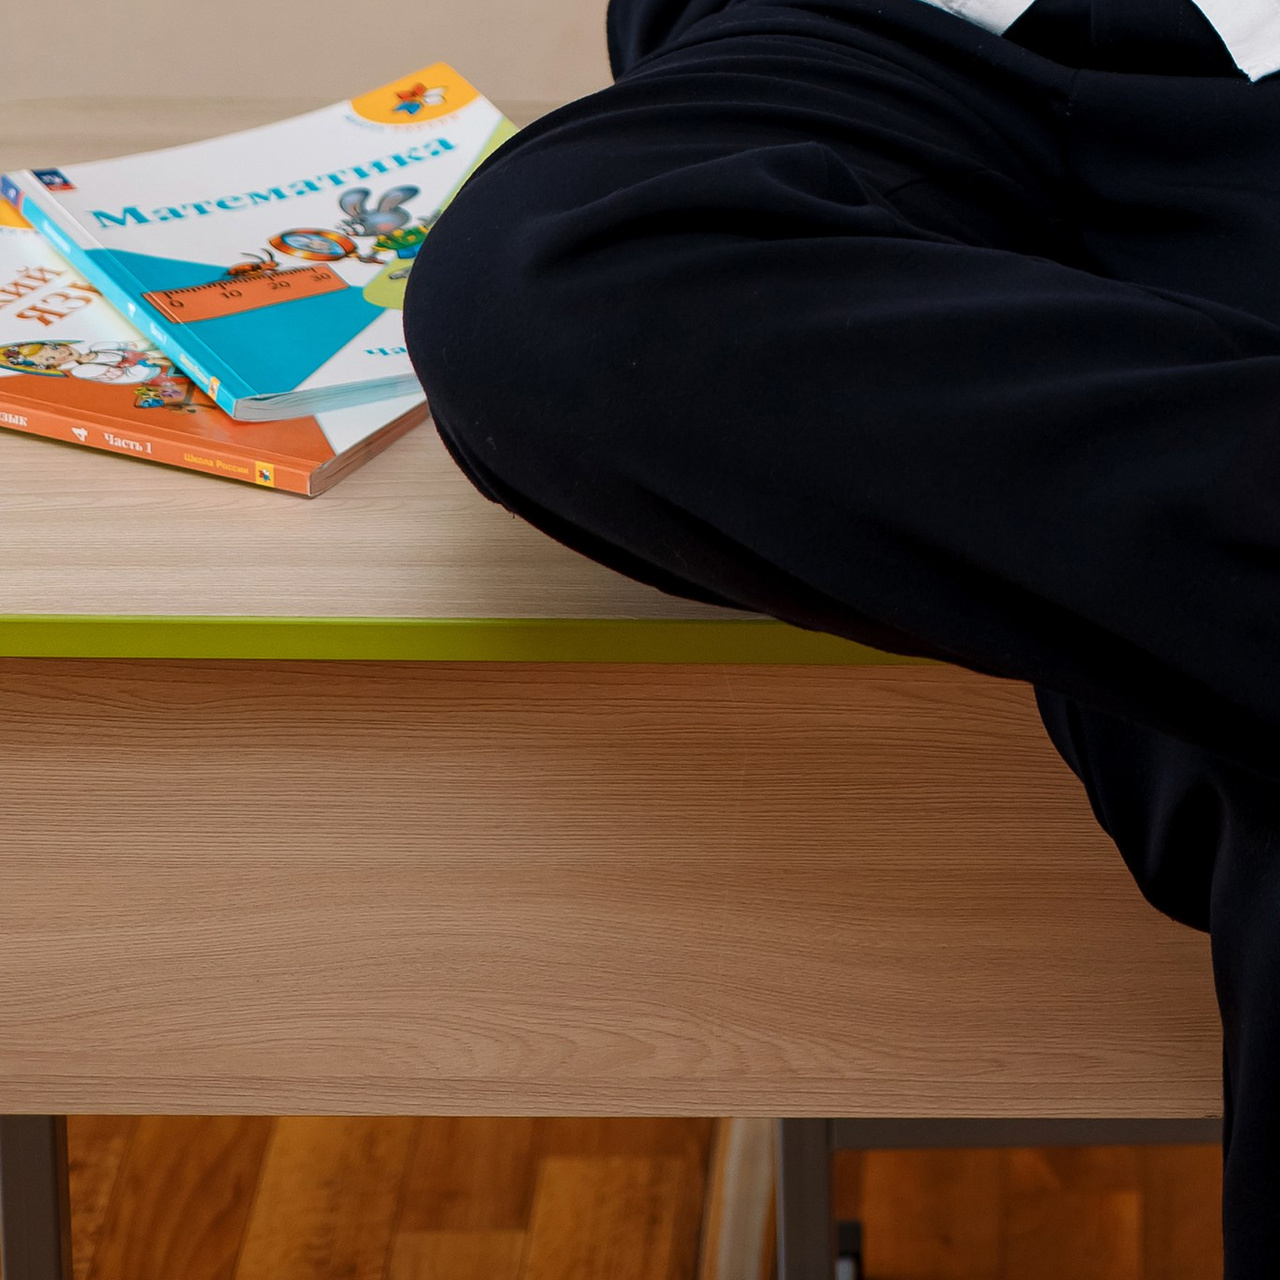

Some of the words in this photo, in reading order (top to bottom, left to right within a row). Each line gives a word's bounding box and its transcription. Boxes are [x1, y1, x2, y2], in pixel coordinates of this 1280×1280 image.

[86, 136, 457, 230] Математика
[220, 289, 243, 300] 10
[267, 280, 291, 291] 20
[103, 432, 144, 453] Часть
